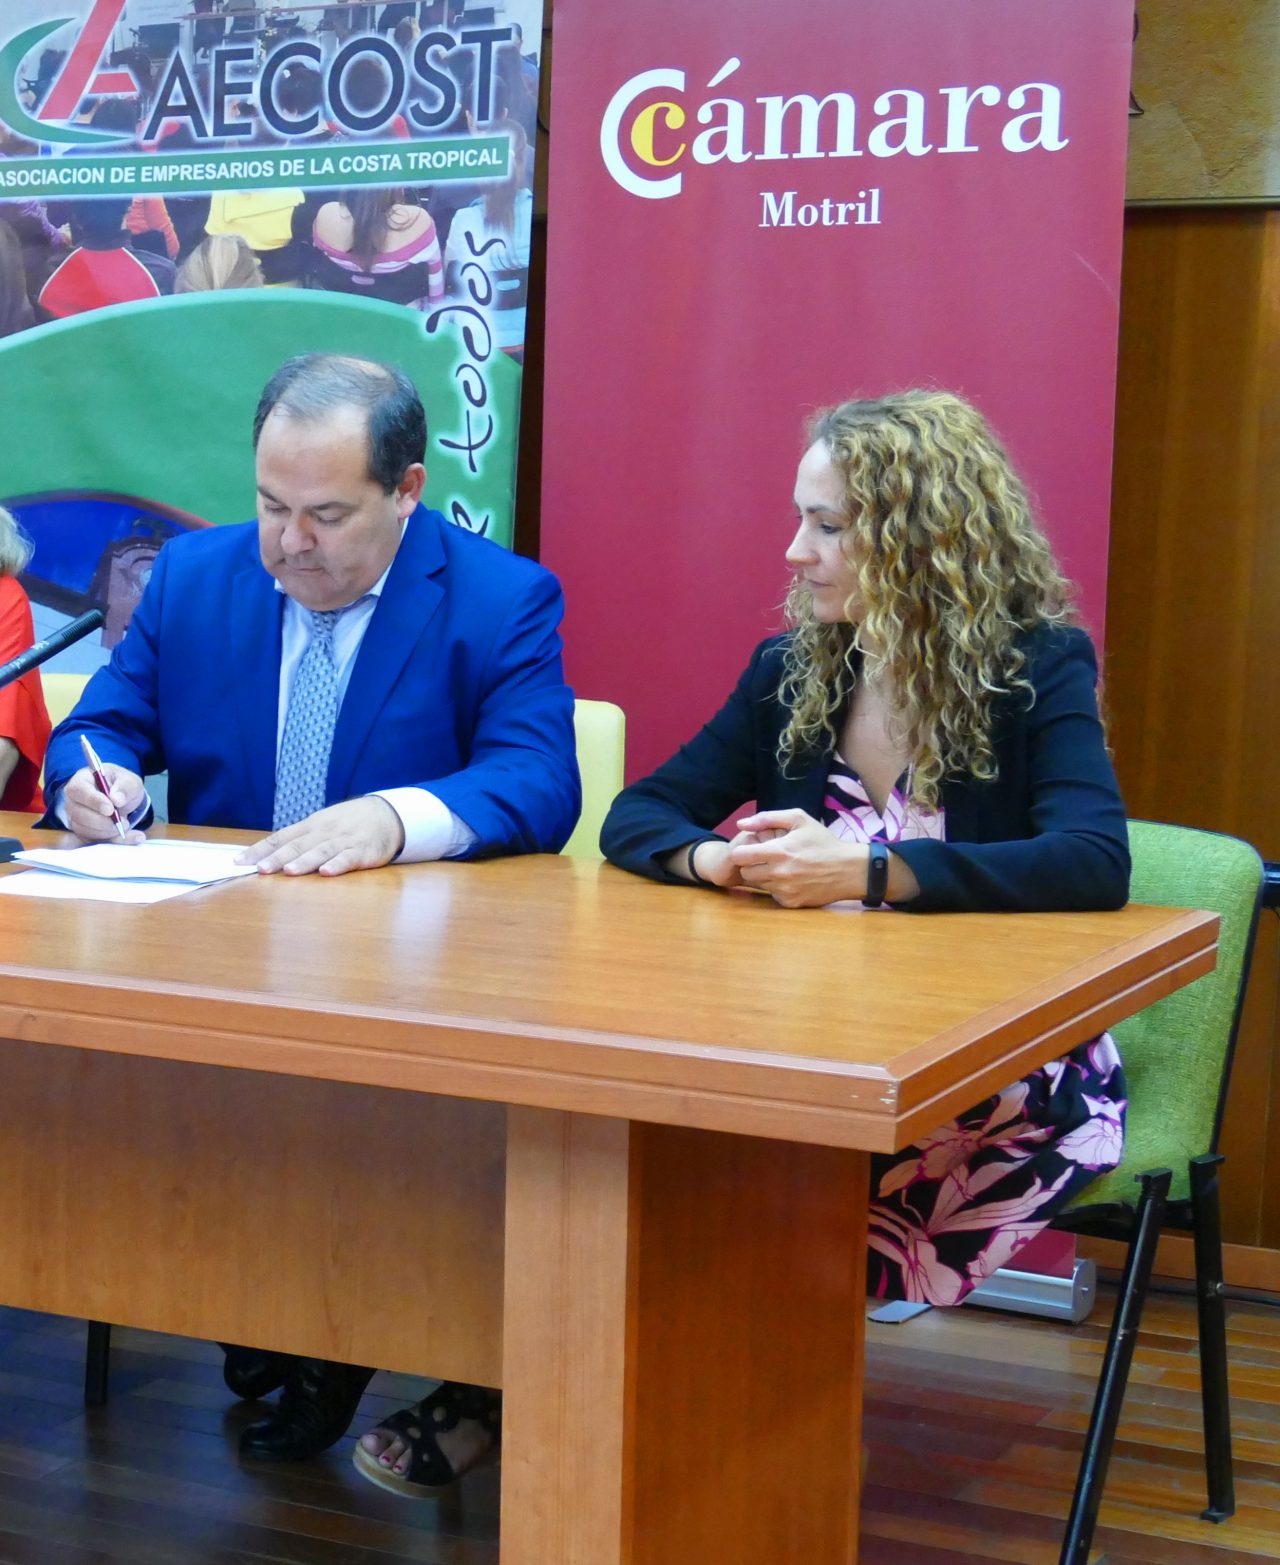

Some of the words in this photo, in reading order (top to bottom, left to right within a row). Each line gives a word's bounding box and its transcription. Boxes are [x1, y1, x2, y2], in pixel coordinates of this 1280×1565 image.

[143, 28, 512, 141] AECOST
[110, 166, 136, 183] DE
[141, 159, 274, 182] EMPRESARIOS
[279, 158, 305, 176] DE
[310, 157, 334, 175] LA
[339, 153, 402, 173] COSTA
[407, 147, 503, 170] TROPICAL
[758, 188, 882, 227] Motril
[425, 230, 507, 473] todos
